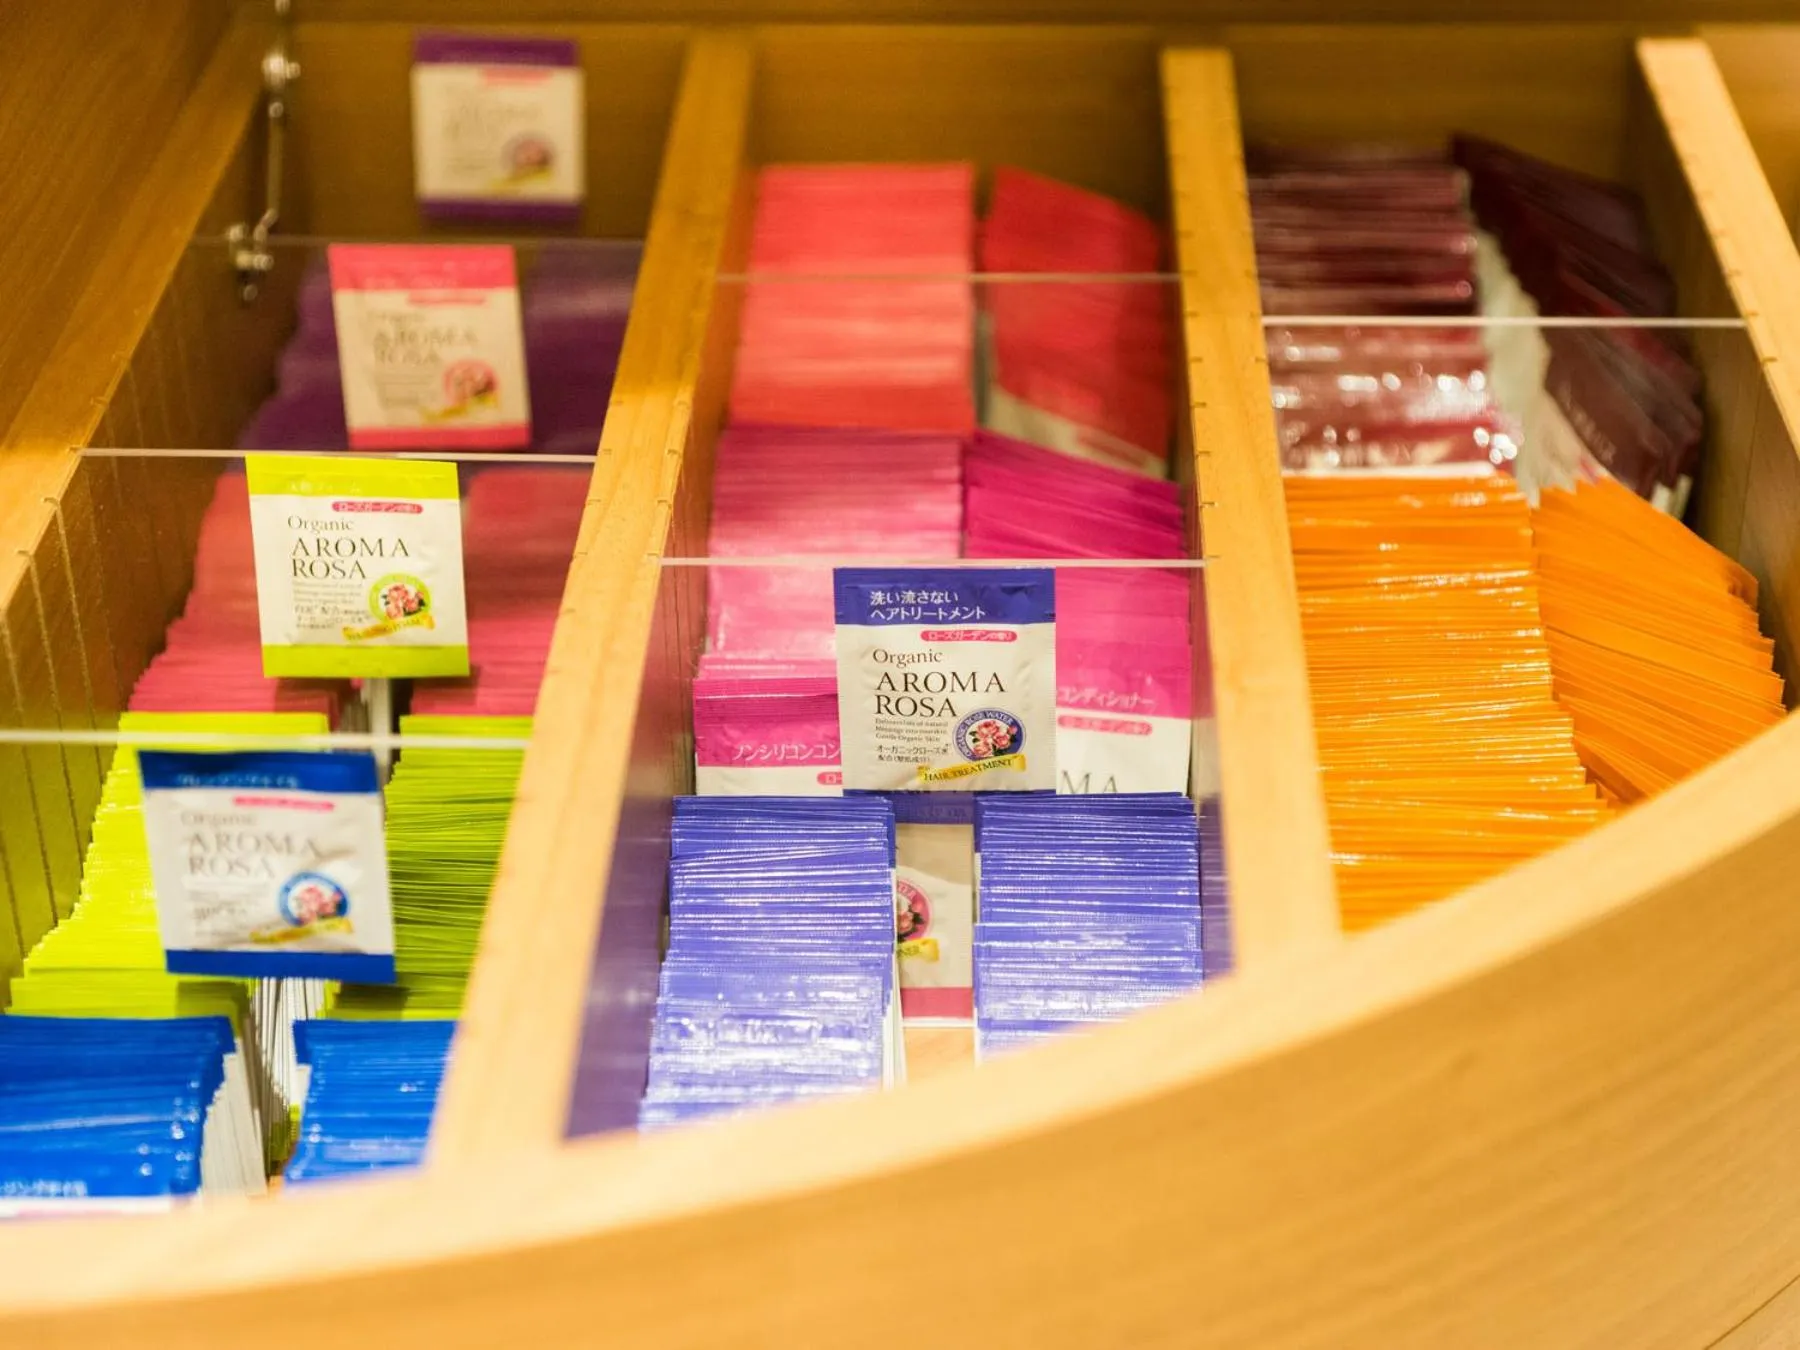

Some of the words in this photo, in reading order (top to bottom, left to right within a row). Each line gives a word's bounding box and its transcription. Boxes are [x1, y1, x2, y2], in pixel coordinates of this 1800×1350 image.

[288, 515, 353, 534] Organic
[292, 537, 409, 557] AROMA
[292, 558, 366, 579] ROSA
[870, 590, 959, 606] 洗い流さない
[870, 606, 985, 621] ヘアトリートメント
[872, 648, 943, 669] Organic
[875, 671, 1006, 693] AROMA
[874, 694, 958, 718] ROSA
[924, 771, 951, 782] HAIR
[952, 758, 1012, 778] TREATMENT
[185, 831, 322, 859] AROMA
[188, 855, 276, 879] ROSA
